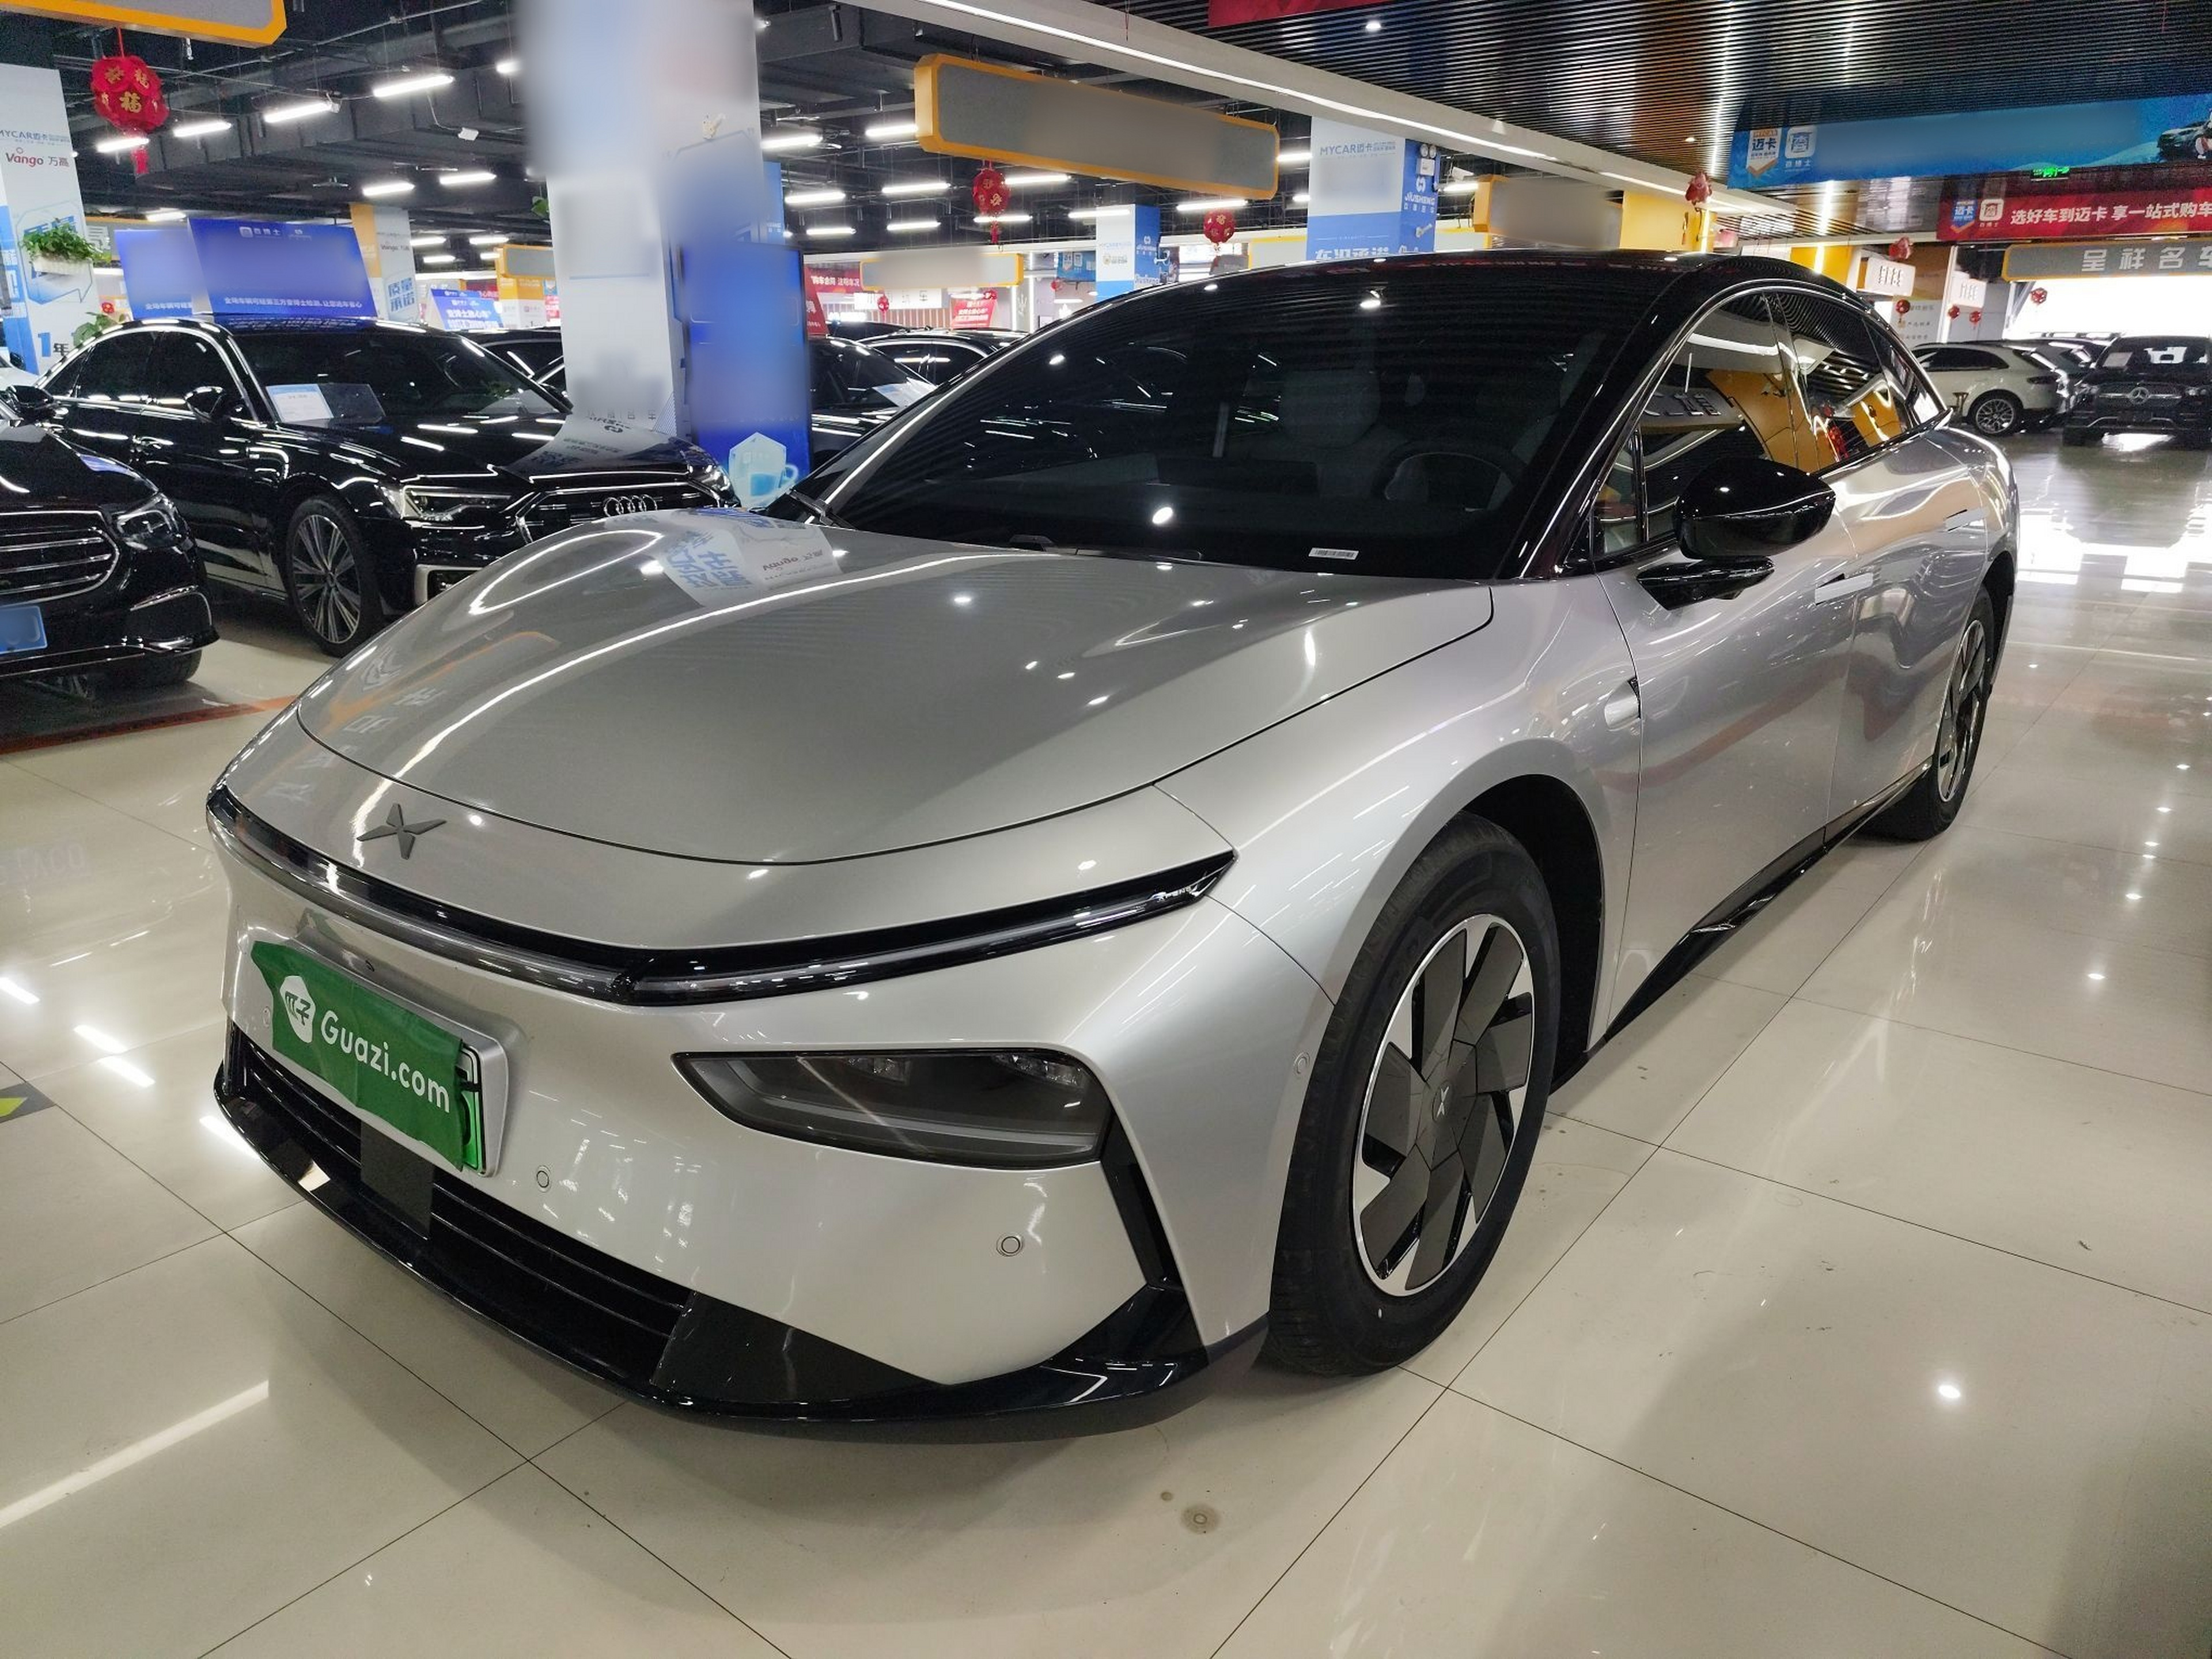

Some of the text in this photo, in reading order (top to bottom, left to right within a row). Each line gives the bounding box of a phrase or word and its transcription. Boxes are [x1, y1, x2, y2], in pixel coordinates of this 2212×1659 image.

[1752, 138, 1777, 151] 迈卡
[6, 152, 44, 168] Vango
[2010, 201, 2212, 225] 选好车到迈卡 享一站式购车
[320, 1010, 450, 1113] Guazi.com
